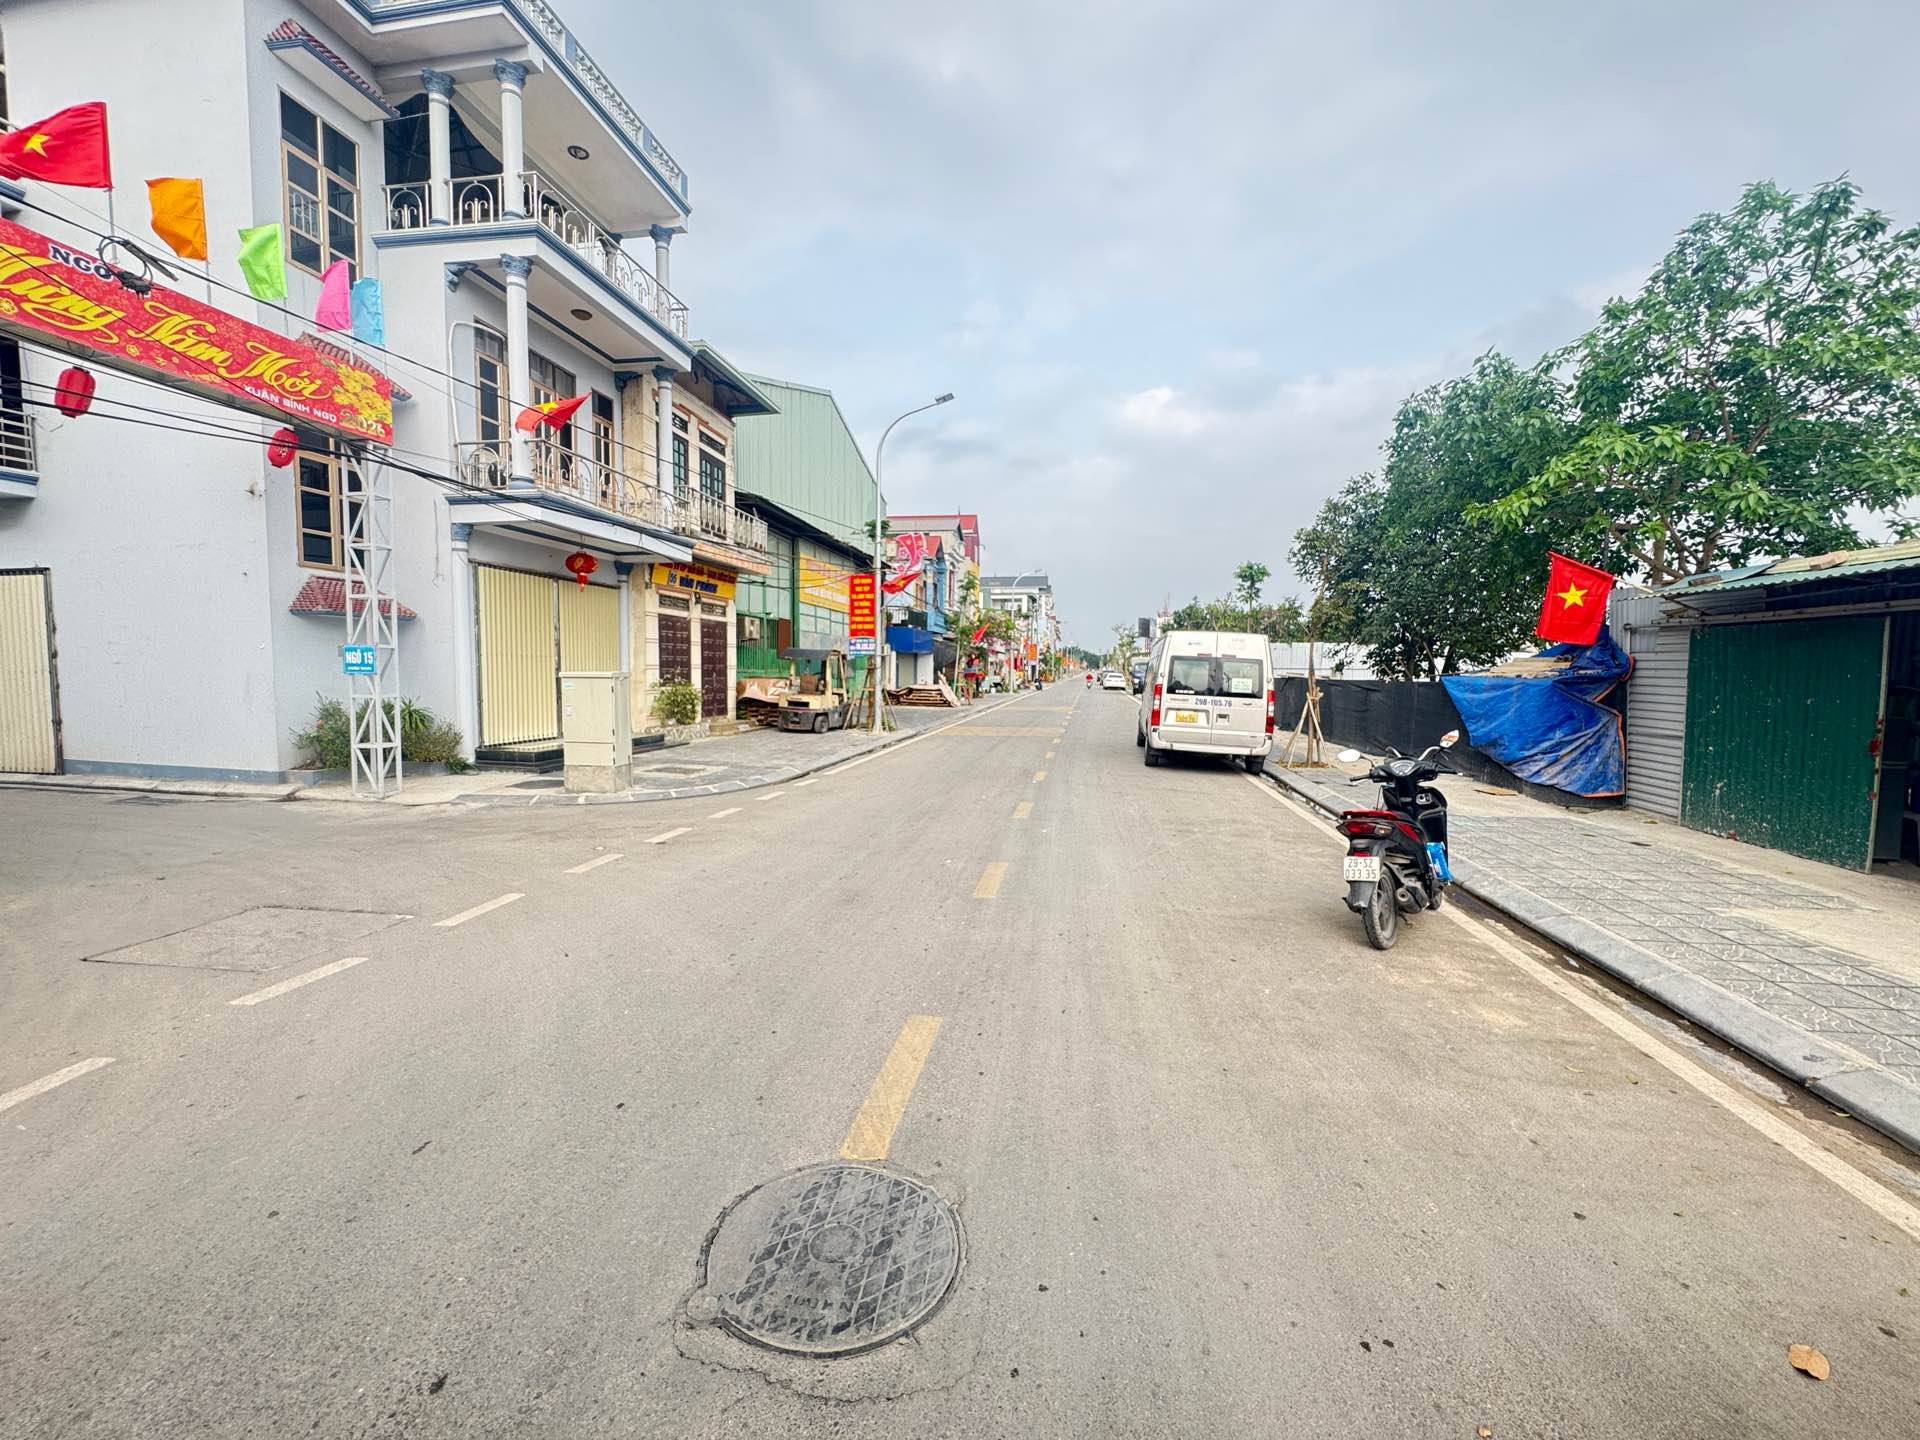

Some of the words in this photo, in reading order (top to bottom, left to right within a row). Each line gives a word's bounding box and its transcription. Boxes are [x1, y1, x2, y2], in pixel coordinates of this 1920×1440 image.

[127, 301, 234, 367] Năm
[217, 341, 331, 399] Mới
[243, 384, 279, 404] XUÂN
[283, 399, 310, 413] BÍNH
[313, 408, 337, 424] NGỌ
[339, 409, 385, 437] 2026
[363, 652, 373, 664] 15
